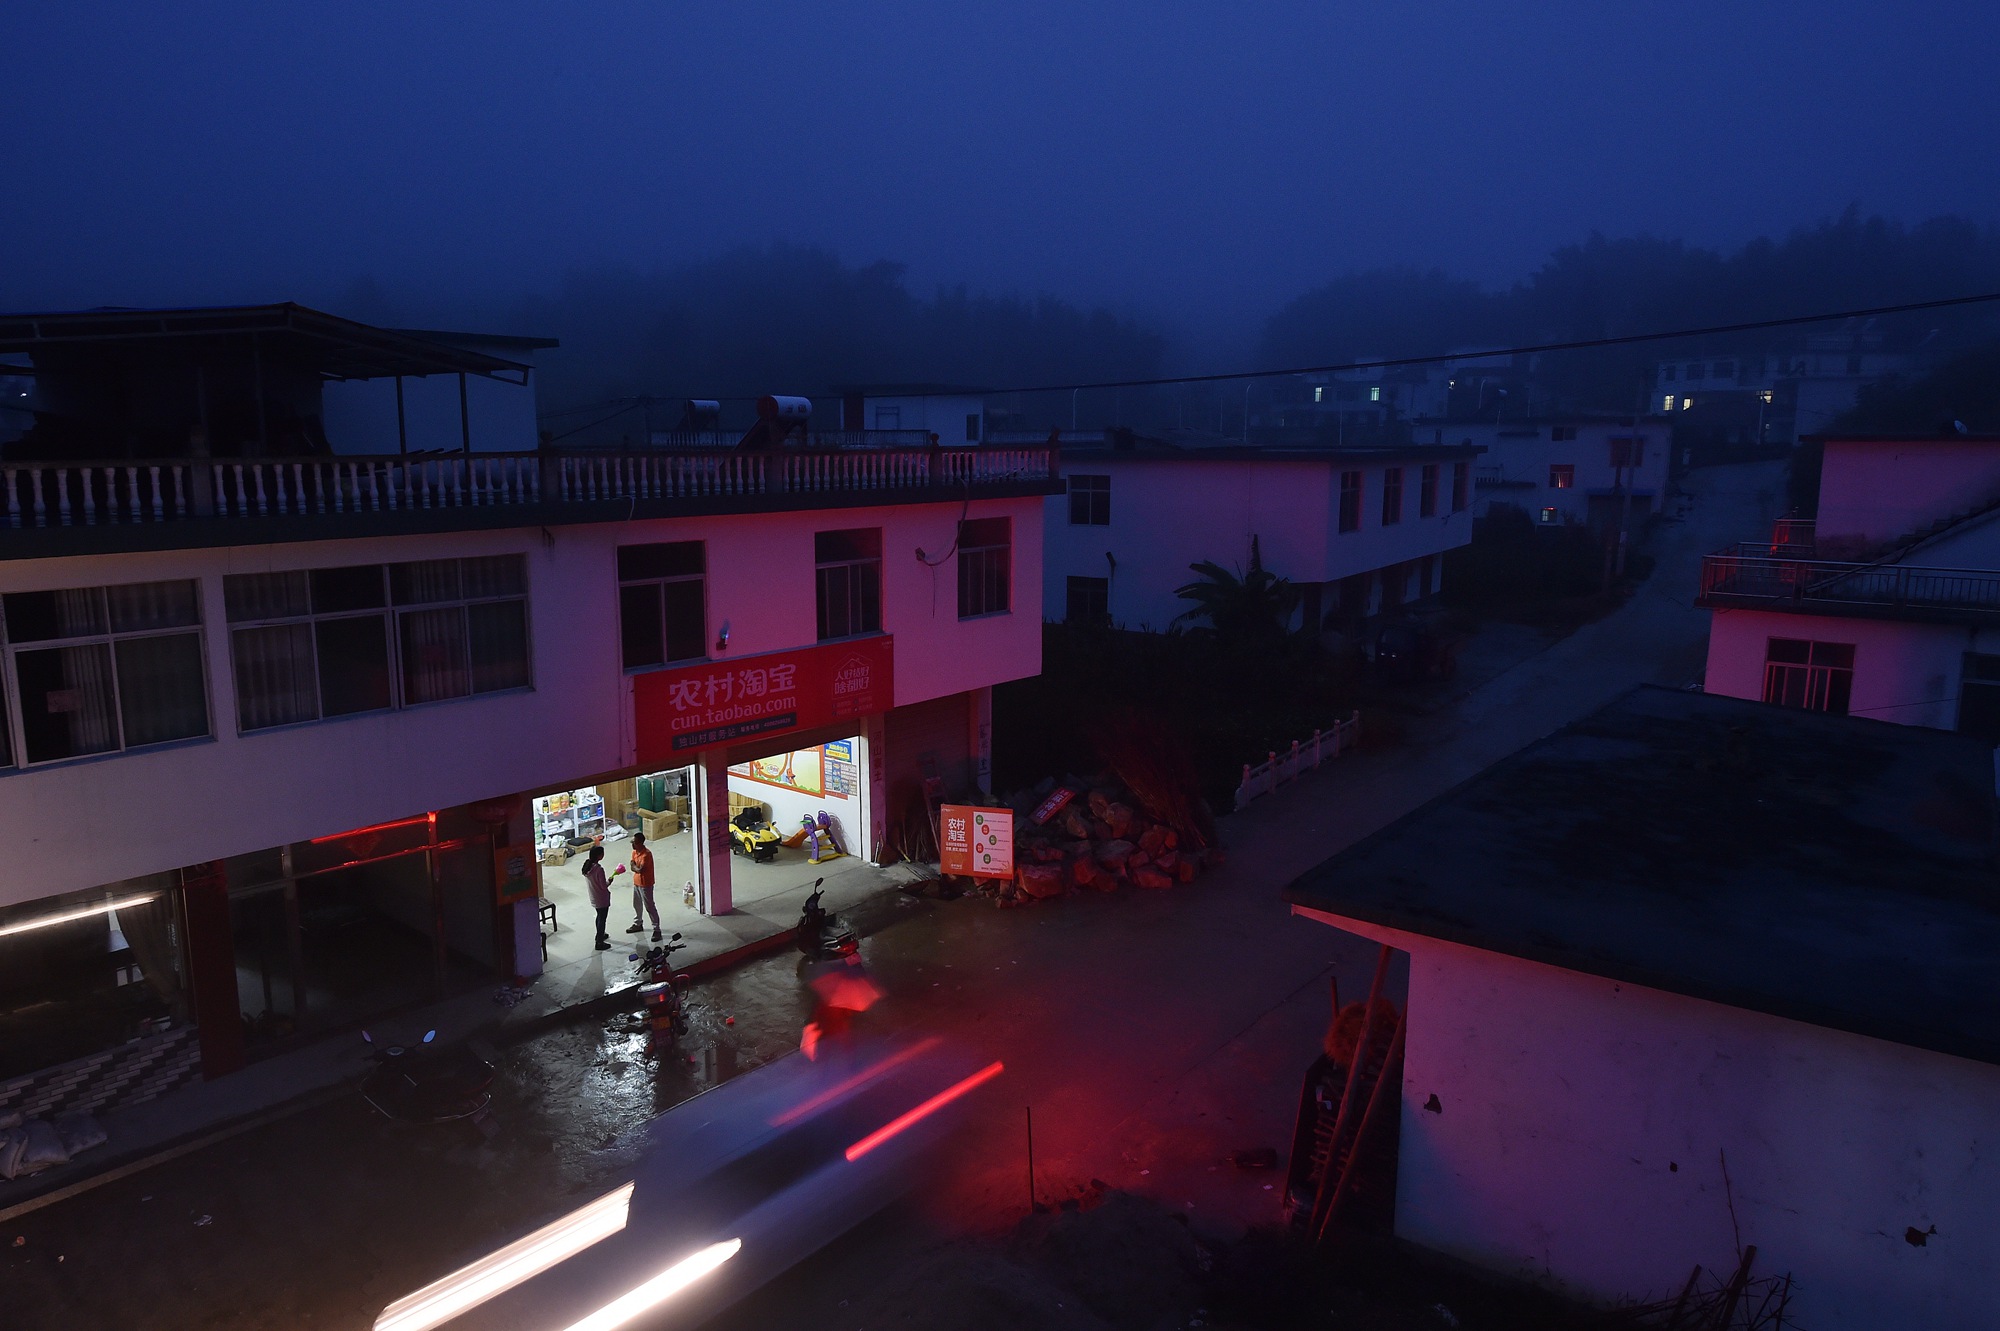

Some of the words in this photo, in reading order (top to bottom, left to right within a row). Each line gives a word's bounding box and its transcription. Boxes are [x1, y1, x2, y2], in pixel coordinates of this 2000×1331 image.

[669, 664, 796, 712] 农村淘宝
[835, 677, 870, 695] 啥都好
[671, 694, 797, 731] cun.taobao.com
[948, 818, 966, 830] 农村
[948, 829, 966, 842] 淘宝
